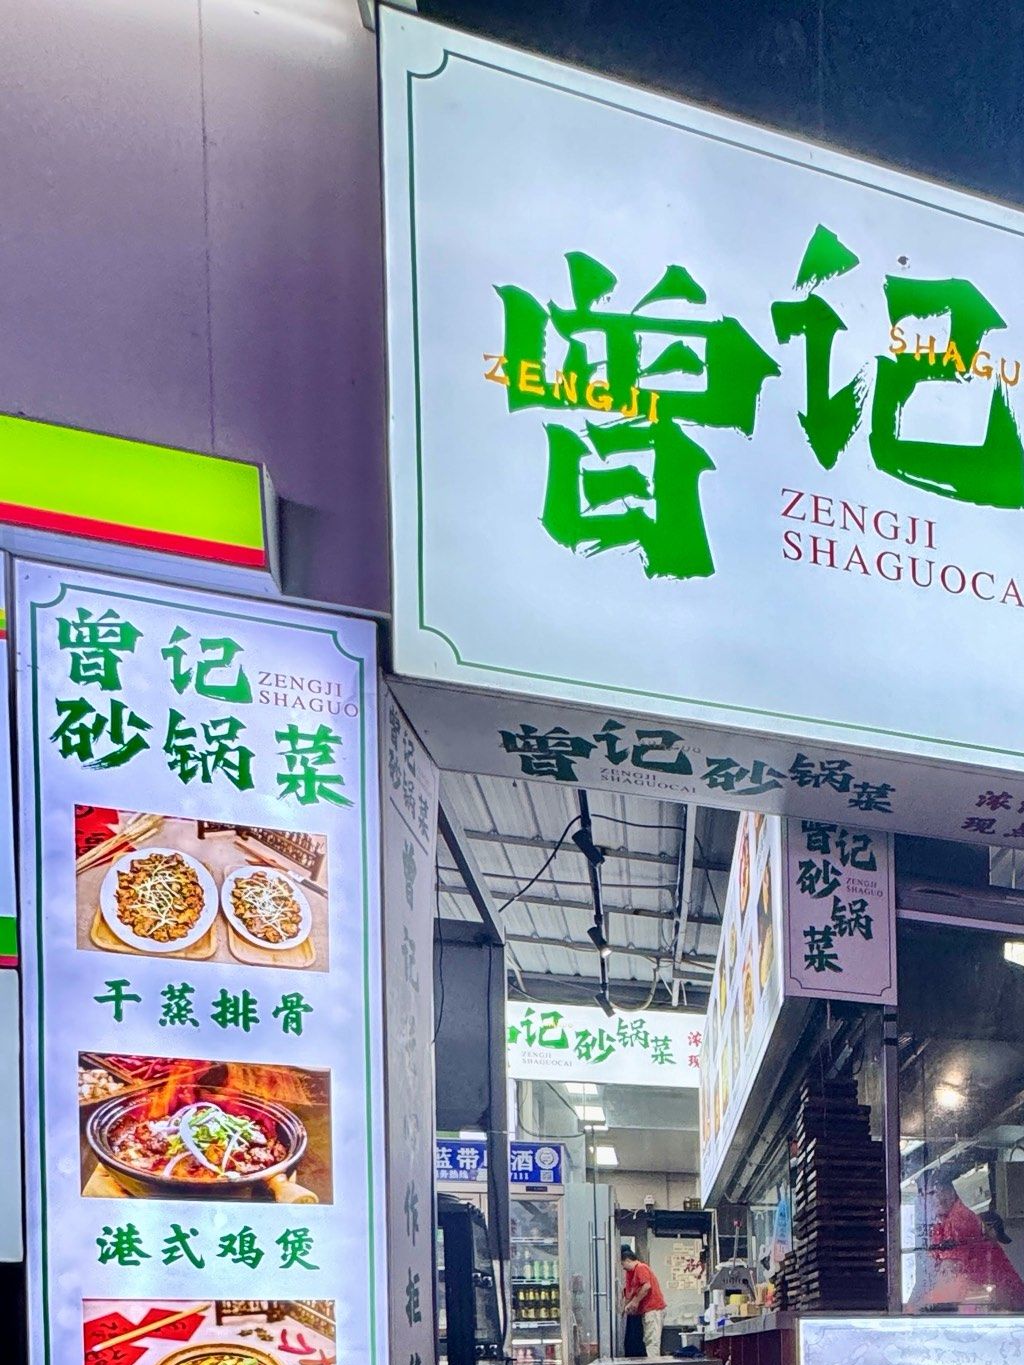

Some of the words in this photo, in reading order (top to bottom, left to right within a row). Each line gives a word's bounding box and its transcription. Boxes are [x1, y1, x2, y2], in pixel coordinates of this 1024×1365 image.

[482, 352, 660, 424] ZENGJI
[780, 488, 938, 550] ZENGJI
[55, 607, 253, 705] 曾记
[258, 670, 343, 698] ZENGJI
[259, 690, 360, 719] SHAGUO
[50, 696, 355, 808] 砂锅菜
[497, 717, 896, 814] 曾记砂锅菜
[600, 767, 656, 781] ZENGJI
[601, 774, 697, 794] SHAGUOCAI
[93, 978, 314, 1037] 干蒸排骨
[507, 1006, 677, 1065] 记砂锅菜
[96, 1223, 321, 1270] 港式鸡煲
